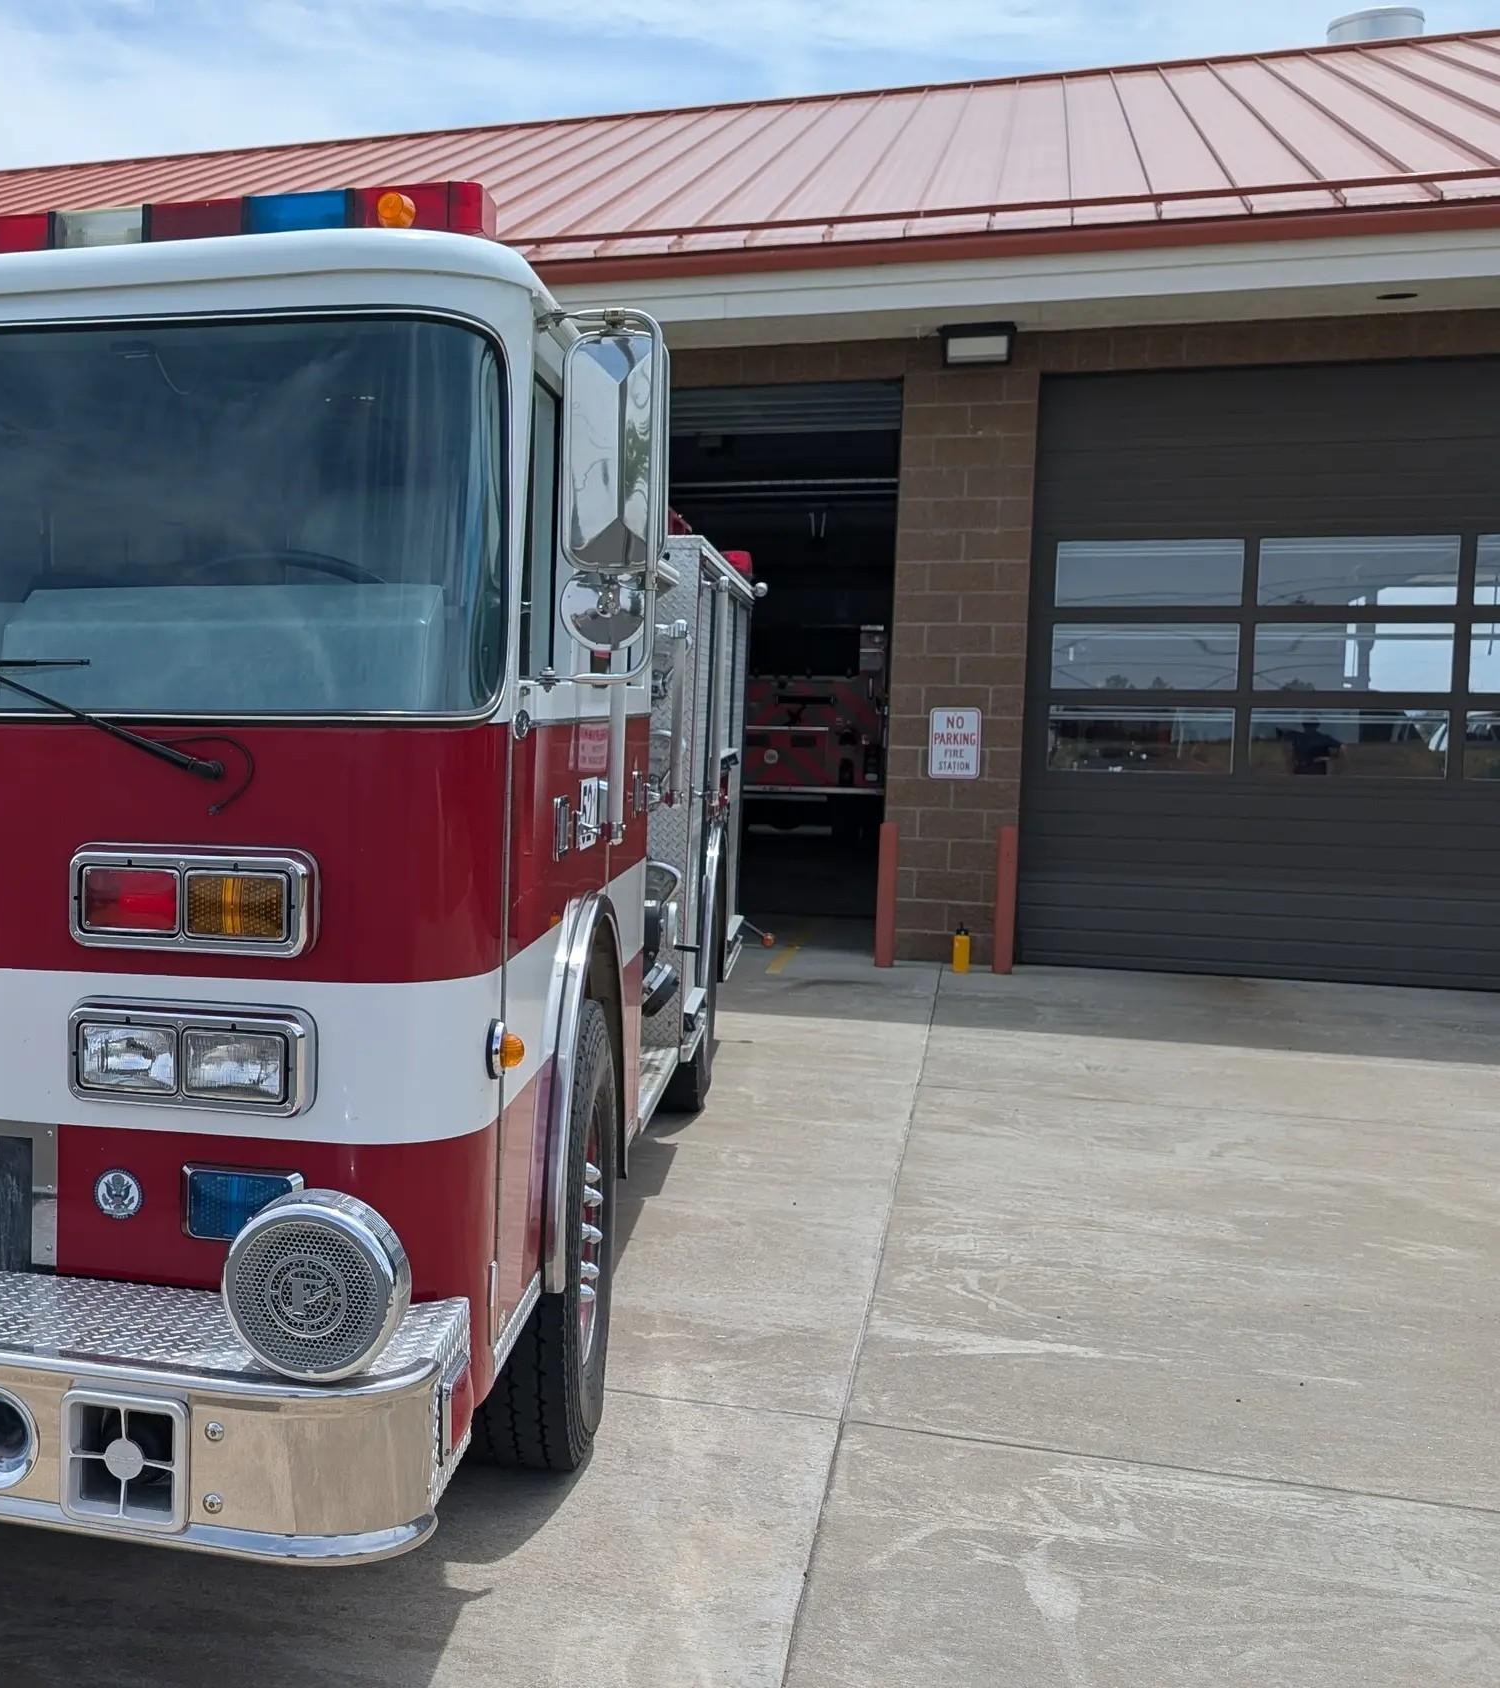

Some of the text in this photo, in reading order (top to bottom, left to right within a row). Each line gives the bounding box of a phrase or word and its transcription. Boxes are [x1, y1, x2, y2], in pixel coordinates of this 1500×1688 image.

[946, 716, 964, 729] NO
[934, 732, 976, 745] PARKING
[944, 749, 964, 758] FIRE
[938, 761, 970, 771] STATION
